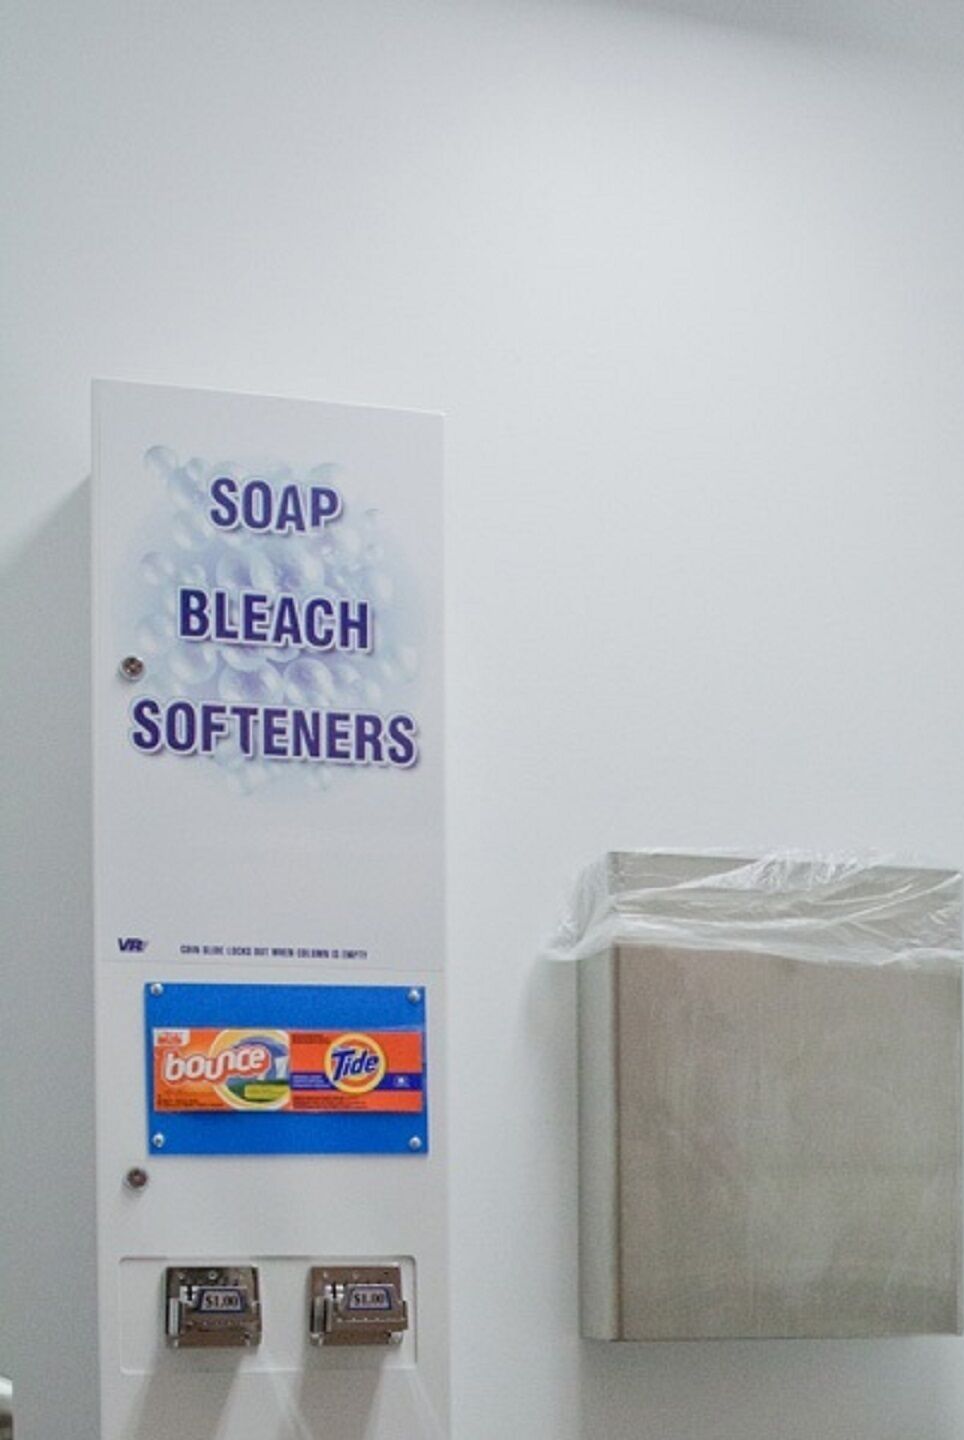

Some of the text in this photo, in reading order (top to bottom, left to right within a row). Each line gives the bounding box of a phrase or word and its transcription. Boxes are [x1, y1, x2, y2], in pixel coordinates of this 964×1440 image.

[209, 477, 341, 532] SOAP
[179, 588, 370, 650] BLEACH
[132, 699, 416, 764] SOFTENERS
[165, 1048, 266, 1081] bounce
[331, 1048, 379, 1081] Tide
